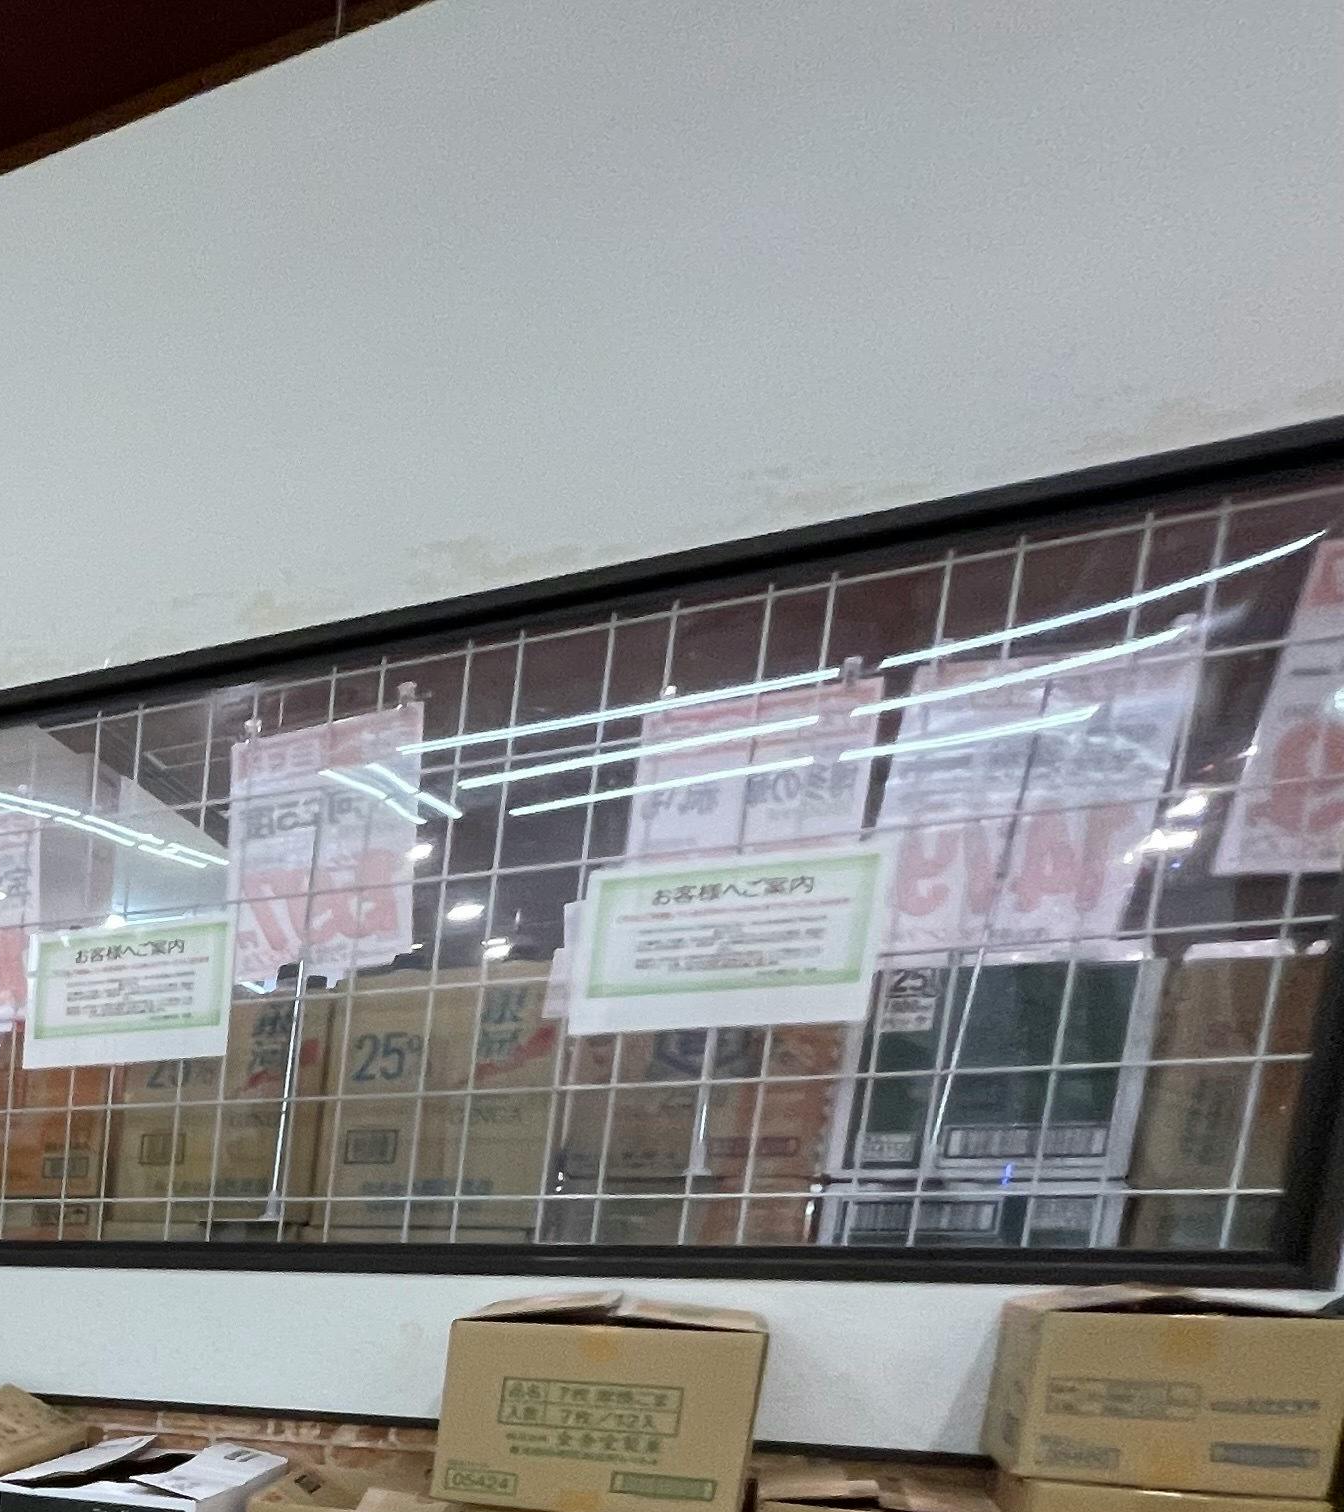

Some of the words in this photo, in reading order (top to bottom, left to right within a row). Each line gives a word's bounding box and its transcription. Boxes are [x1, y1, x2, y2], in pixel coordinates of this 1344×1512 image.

[651, 874, 816, 906] お客様へご案内
[74, 938, 186, 964] お客様へご案内
